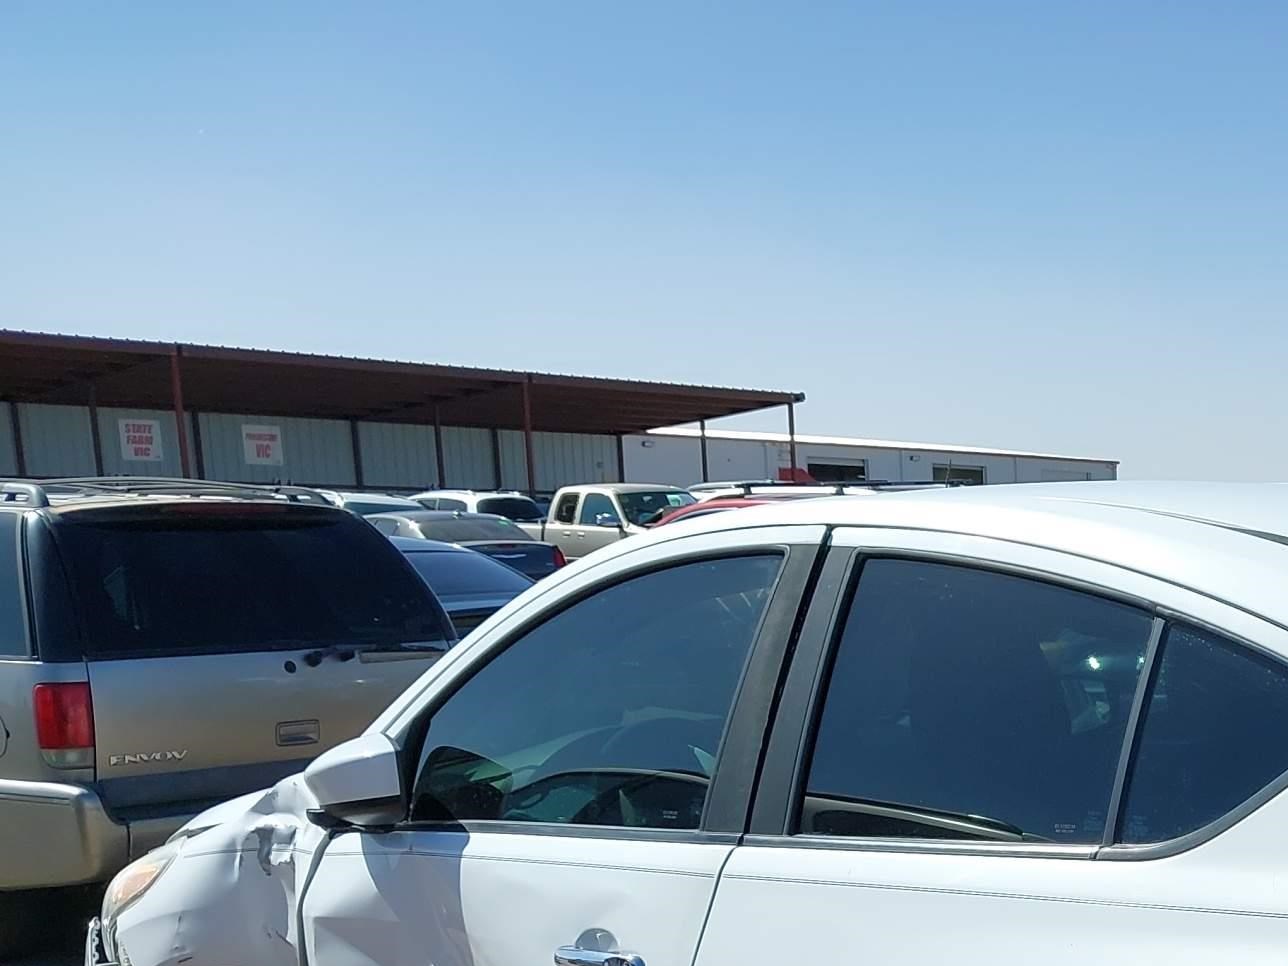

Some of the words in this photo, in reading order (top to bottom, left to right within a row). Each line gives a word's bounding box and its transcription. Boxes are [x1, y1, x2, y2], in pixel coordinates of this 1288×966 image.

[125, 424, 153, 434] STATE
[127, 435, 153, 445] FARM
[134, 447, 151, 457] VIC
[255, 443, 272, 458] VIC
